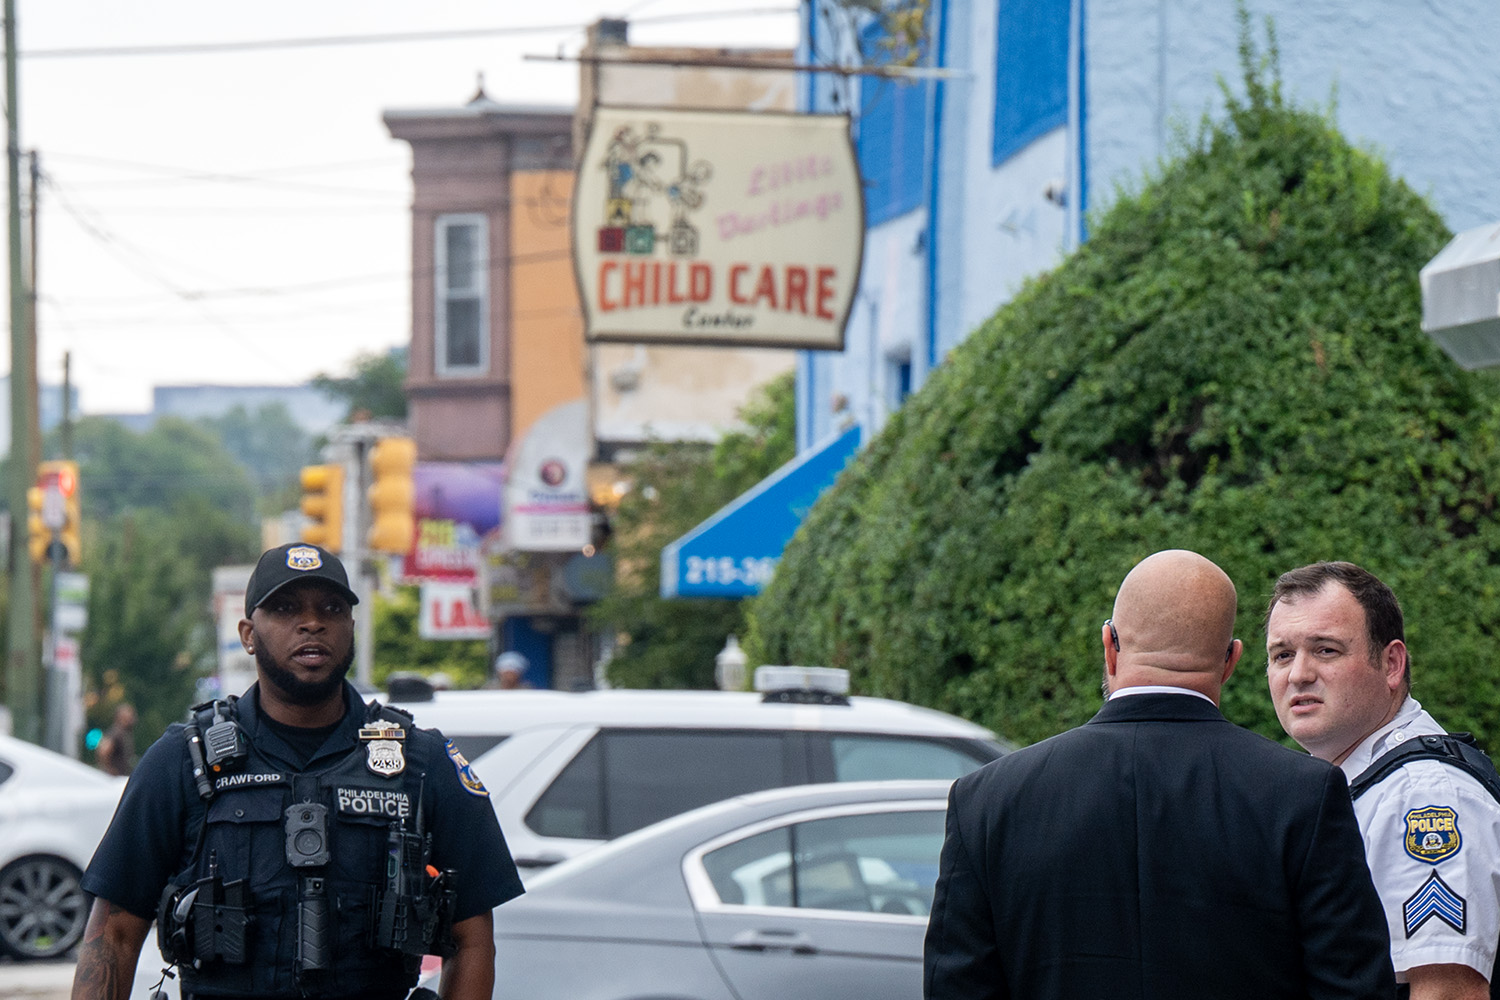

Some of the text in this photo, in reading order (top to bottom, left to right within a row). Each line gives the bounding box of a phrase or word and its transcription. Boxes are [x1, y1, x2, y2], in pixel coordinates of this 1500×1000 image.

[597, 261, 837, 321] CHILD CARE
[216, 773, 281, 789] CRAWFORD
[337, 788, 409, 803] PHILADELPHIA
[339, 796, 409, 817] POLICE
[1410, 818, 1453, 833] POLICE
